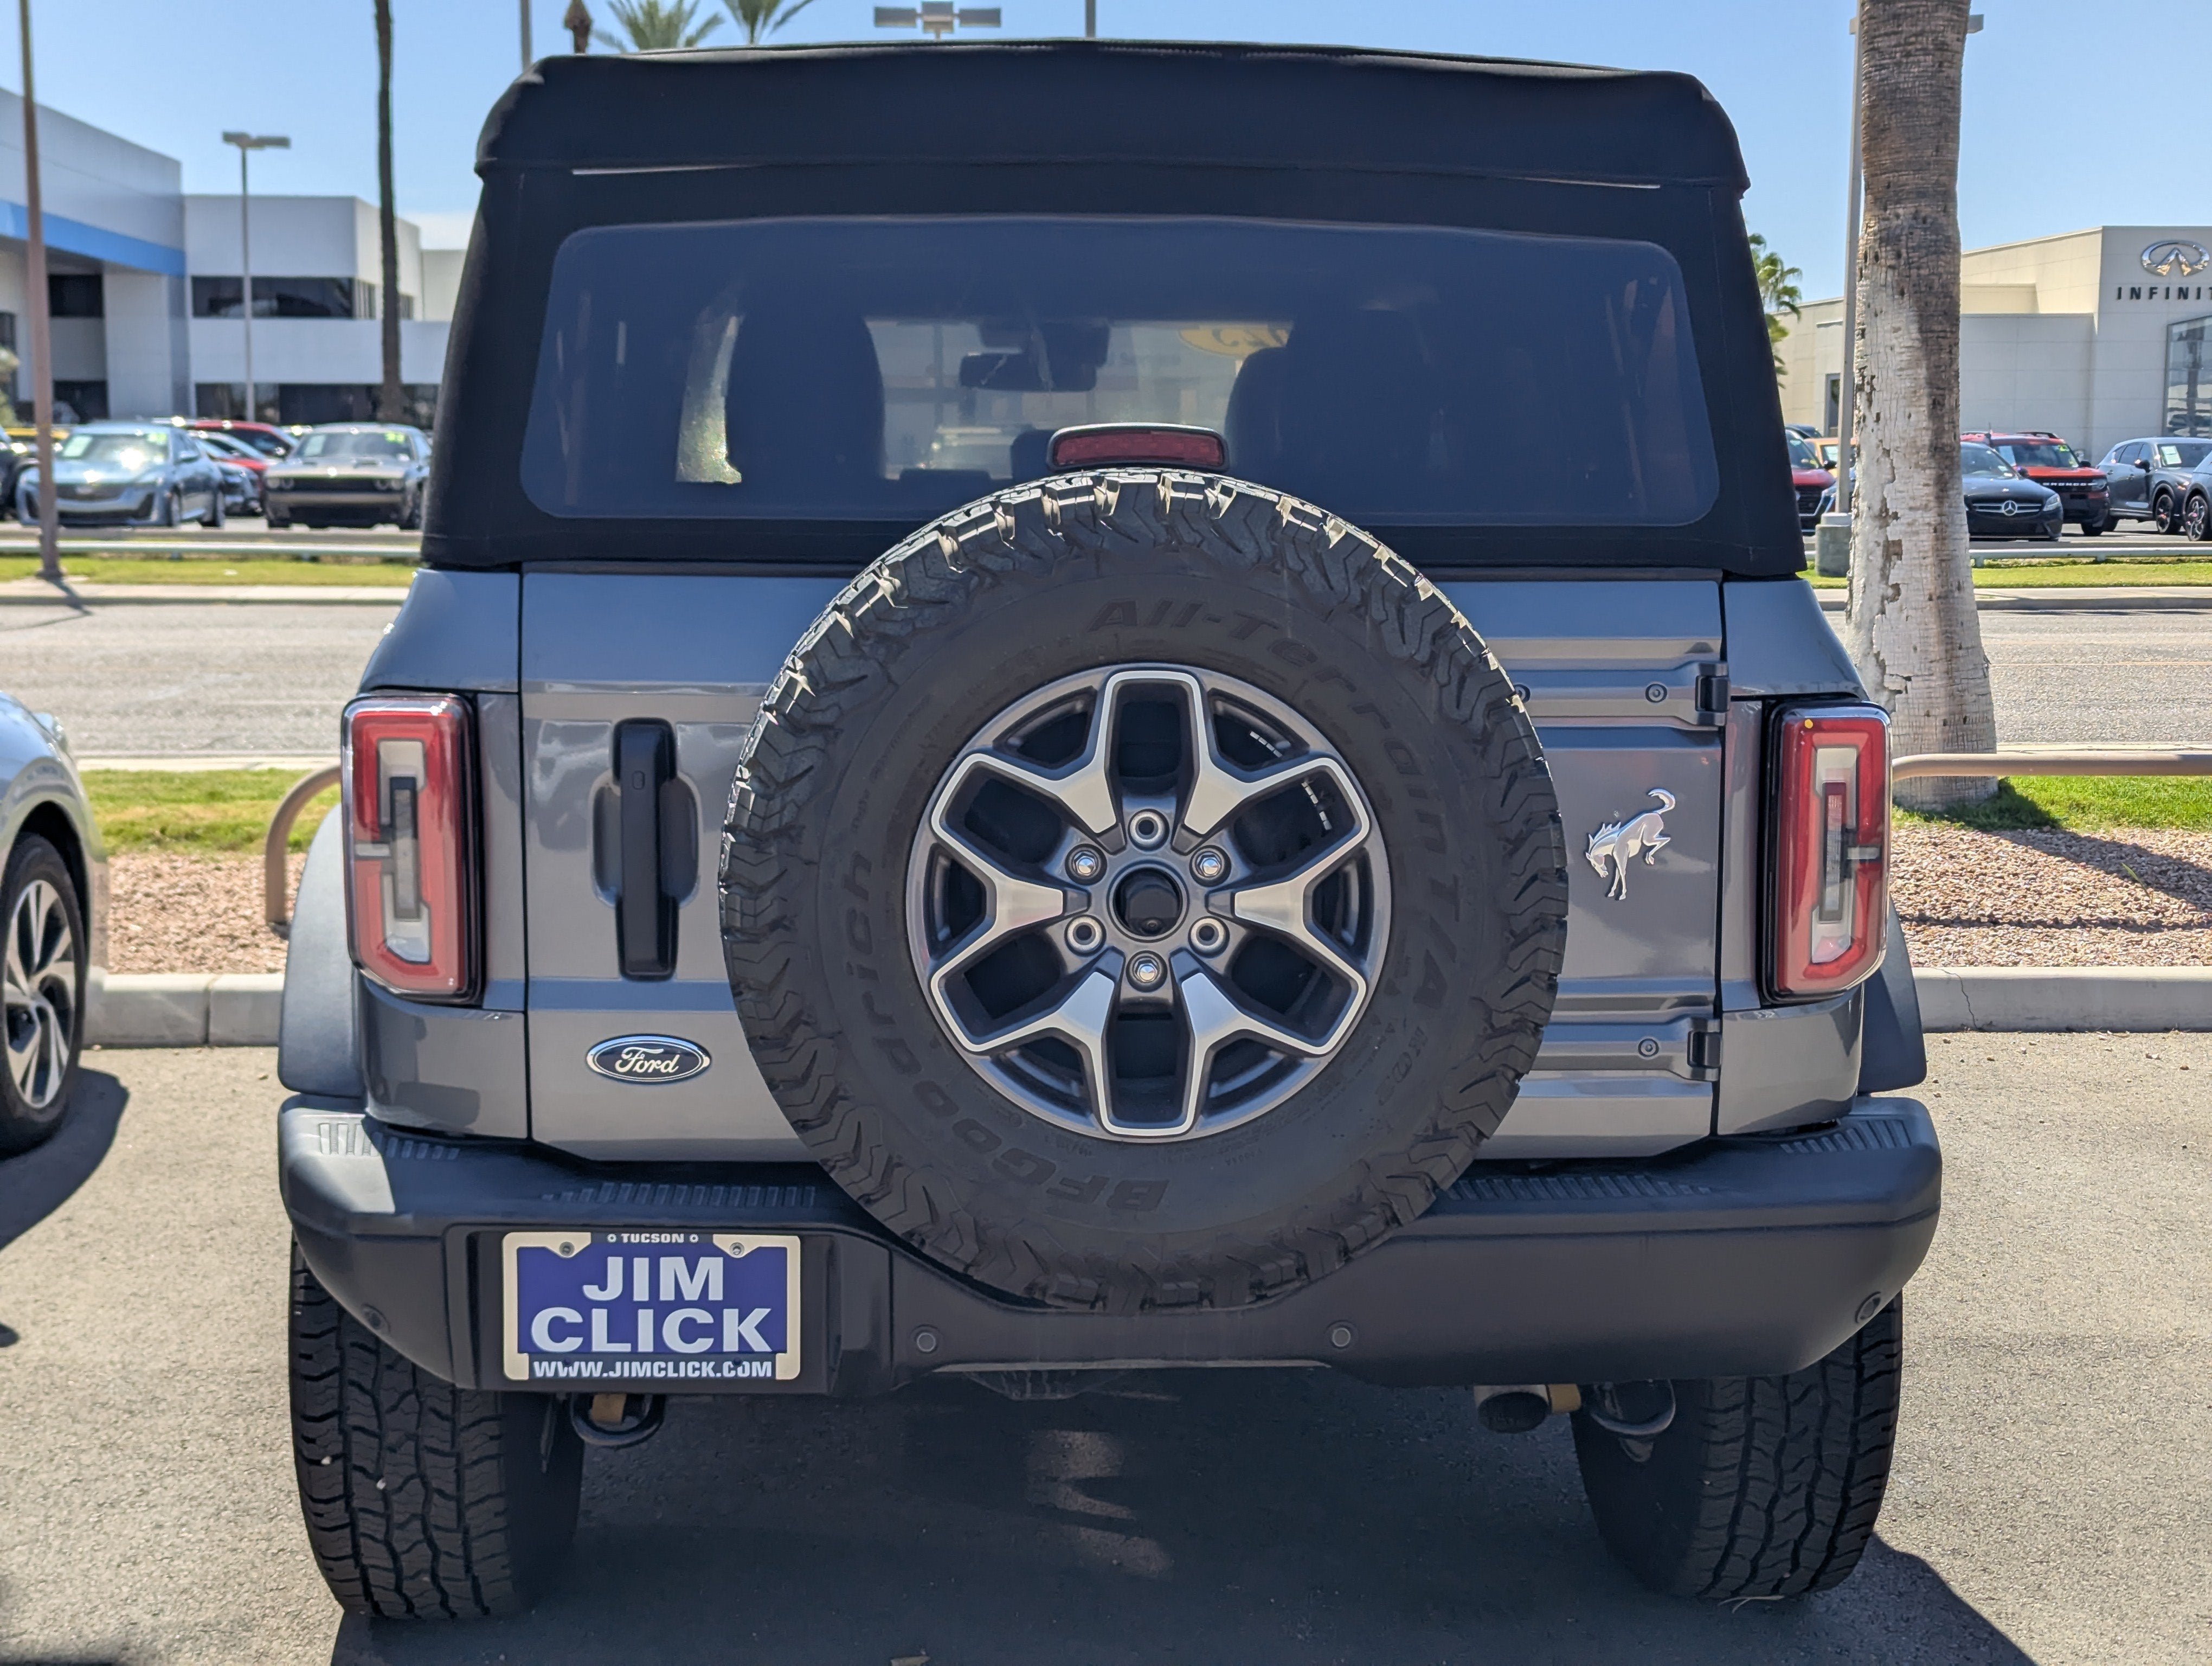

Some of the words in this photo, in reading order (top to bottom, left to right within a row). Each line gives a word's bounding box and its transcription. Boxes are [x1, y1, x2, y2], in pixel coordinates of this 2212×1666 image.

[1086, 597, 1447, 854] All-Terrain
[844, 850, 1170, 1211] BFGoodrich
[614, 1046, 680, 1073] Ford
[621, 1233, 685, 1244] TUCSON
[582, 1256, 724, 1302] JIM
[530, 1306, 773, 1354] CLICK
[532, 1361, 772, 1378] WWW.JIMCLICK.COM
